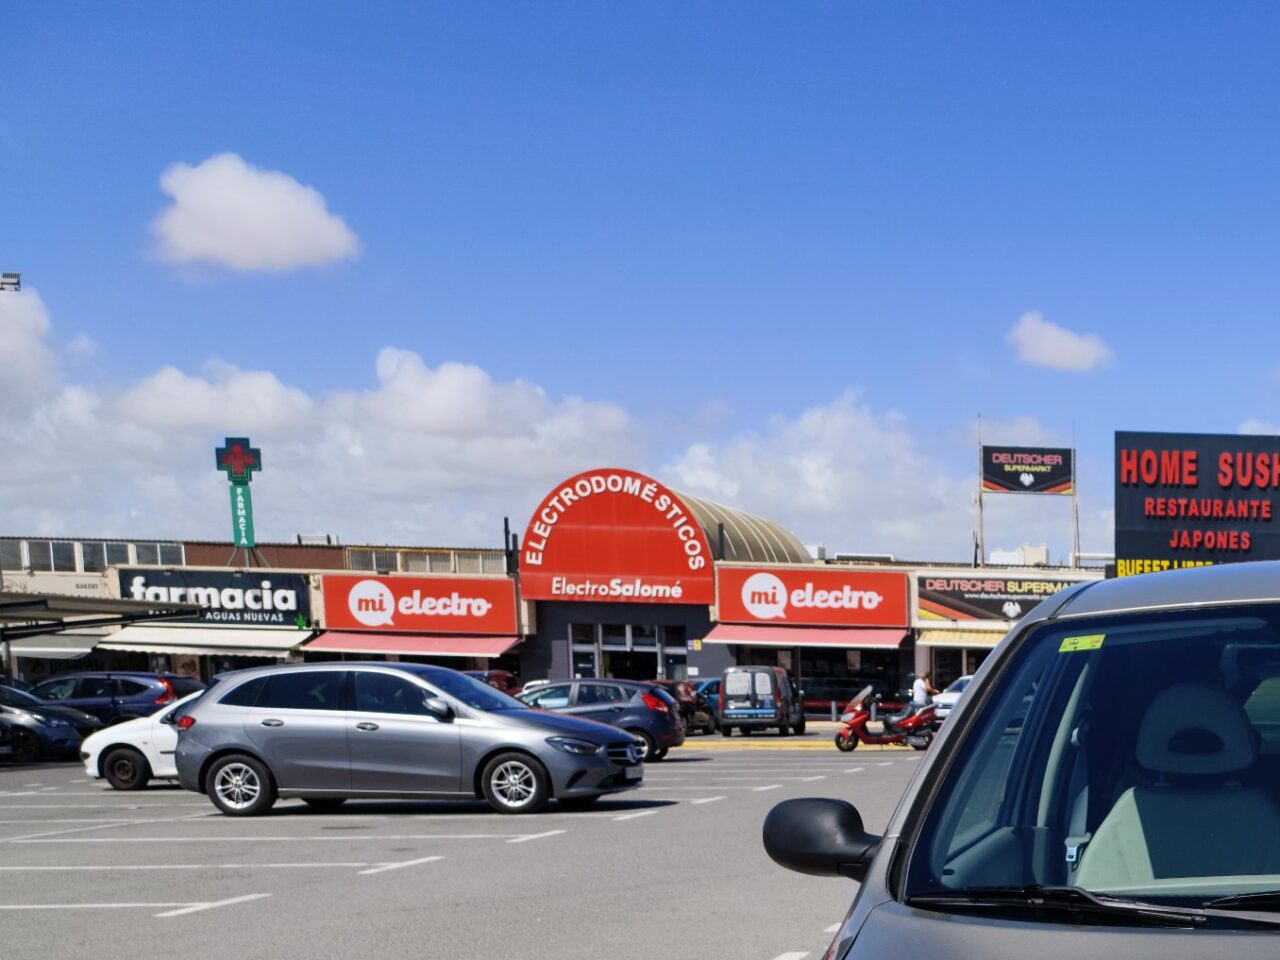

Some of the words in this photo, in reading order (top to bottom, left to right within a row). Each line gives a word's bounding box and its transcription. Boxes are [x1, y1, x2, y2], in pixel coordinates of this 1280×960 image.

[992, 453, 1062, 464] DEUTSCHER
[1004, 464, 1052, 472] SUPERMARKT
[1121, 449, 1198, 484] HOME
[236, 487, 248, 545] FARMACIA
[1144, 498, 1272, 518] RESTAURANTE
[525, 474, 705, 570] ELECTRODOMÉSTICOS
[1169, 530, 1251, 549] JAPONES
[130, 576, 297, 610] farmacia
[750, 586, 780, 605] mi
[790, 583, 884, 610] electro
[925, 579, 1005, 592] DEUTSCHER
[357, 593, 387, 612] mi
[398, 590, 493, 617] electro
[206, 612, 241, 621] AGUAS
[244, 613, 284, 622] NUEVAS
